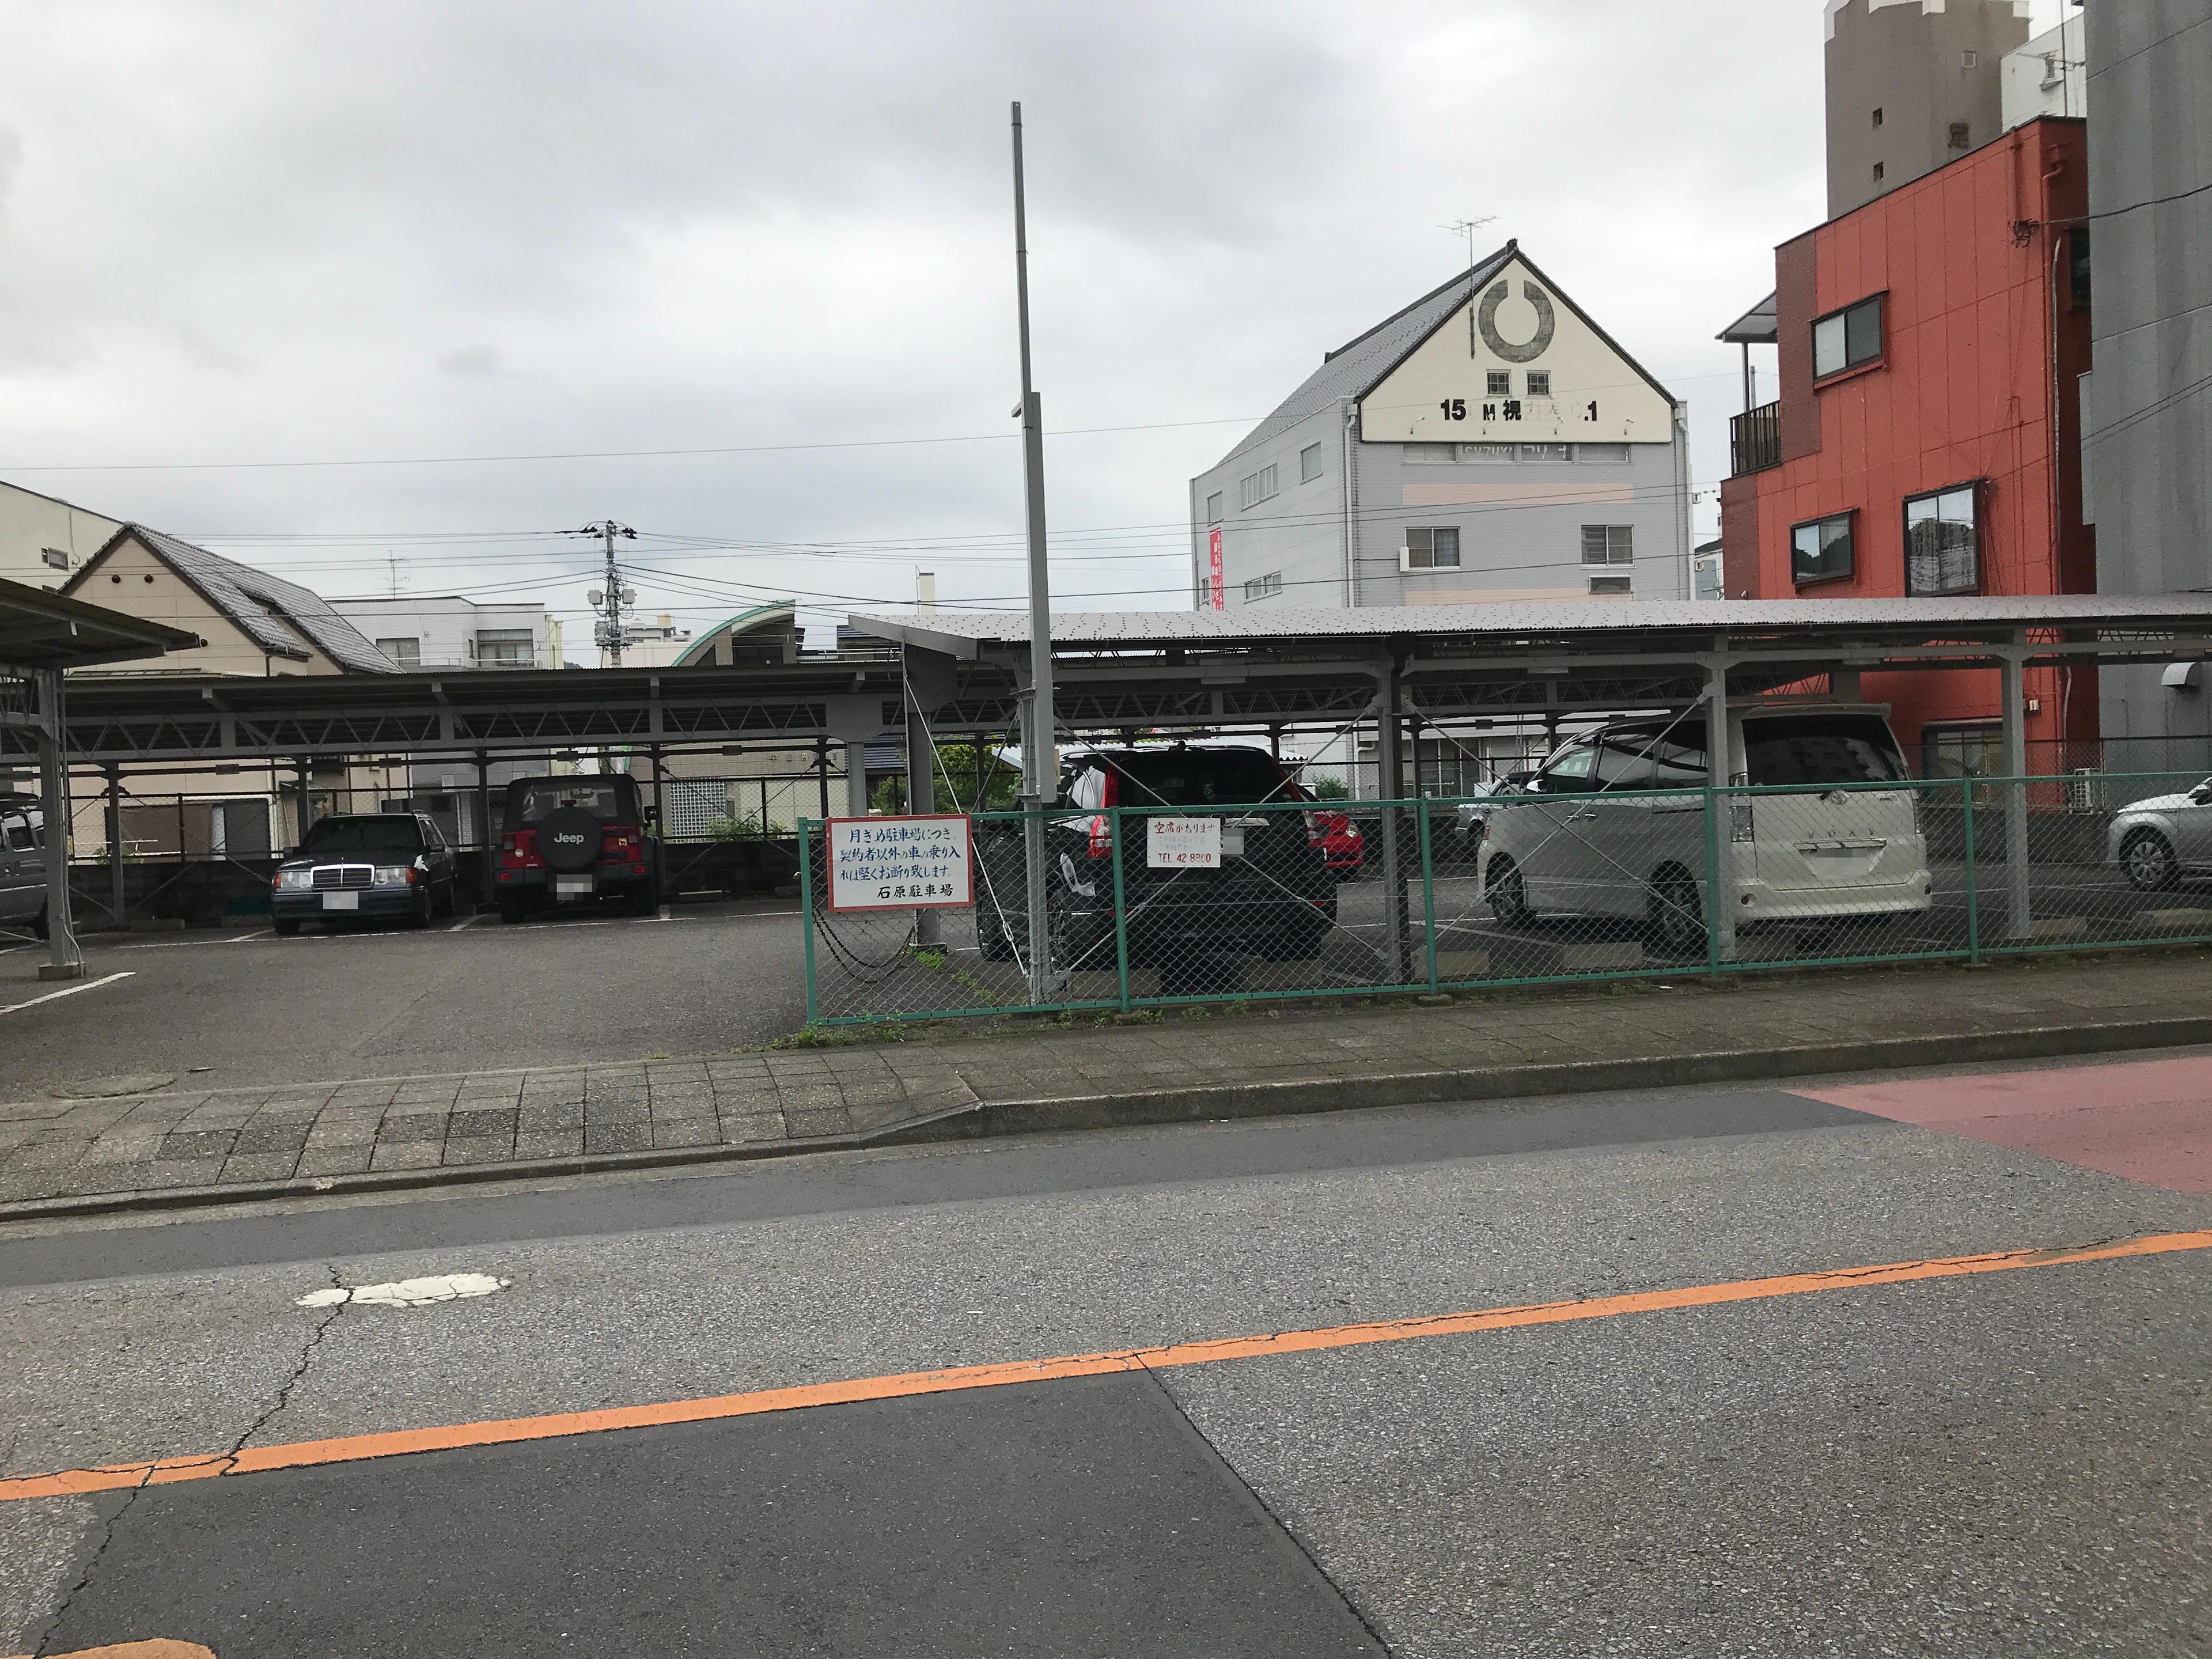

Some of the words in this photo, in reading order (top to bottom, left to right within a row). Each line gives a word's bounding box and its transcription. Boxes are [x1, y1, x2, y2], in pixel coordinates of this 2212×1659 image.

[1441, 399, 1466, 421] 15
[554, 832, 585, 845] Jeep
[1177, 853, 1187, 863] 42
[877, 884, 953, 899] 石原駐車場
